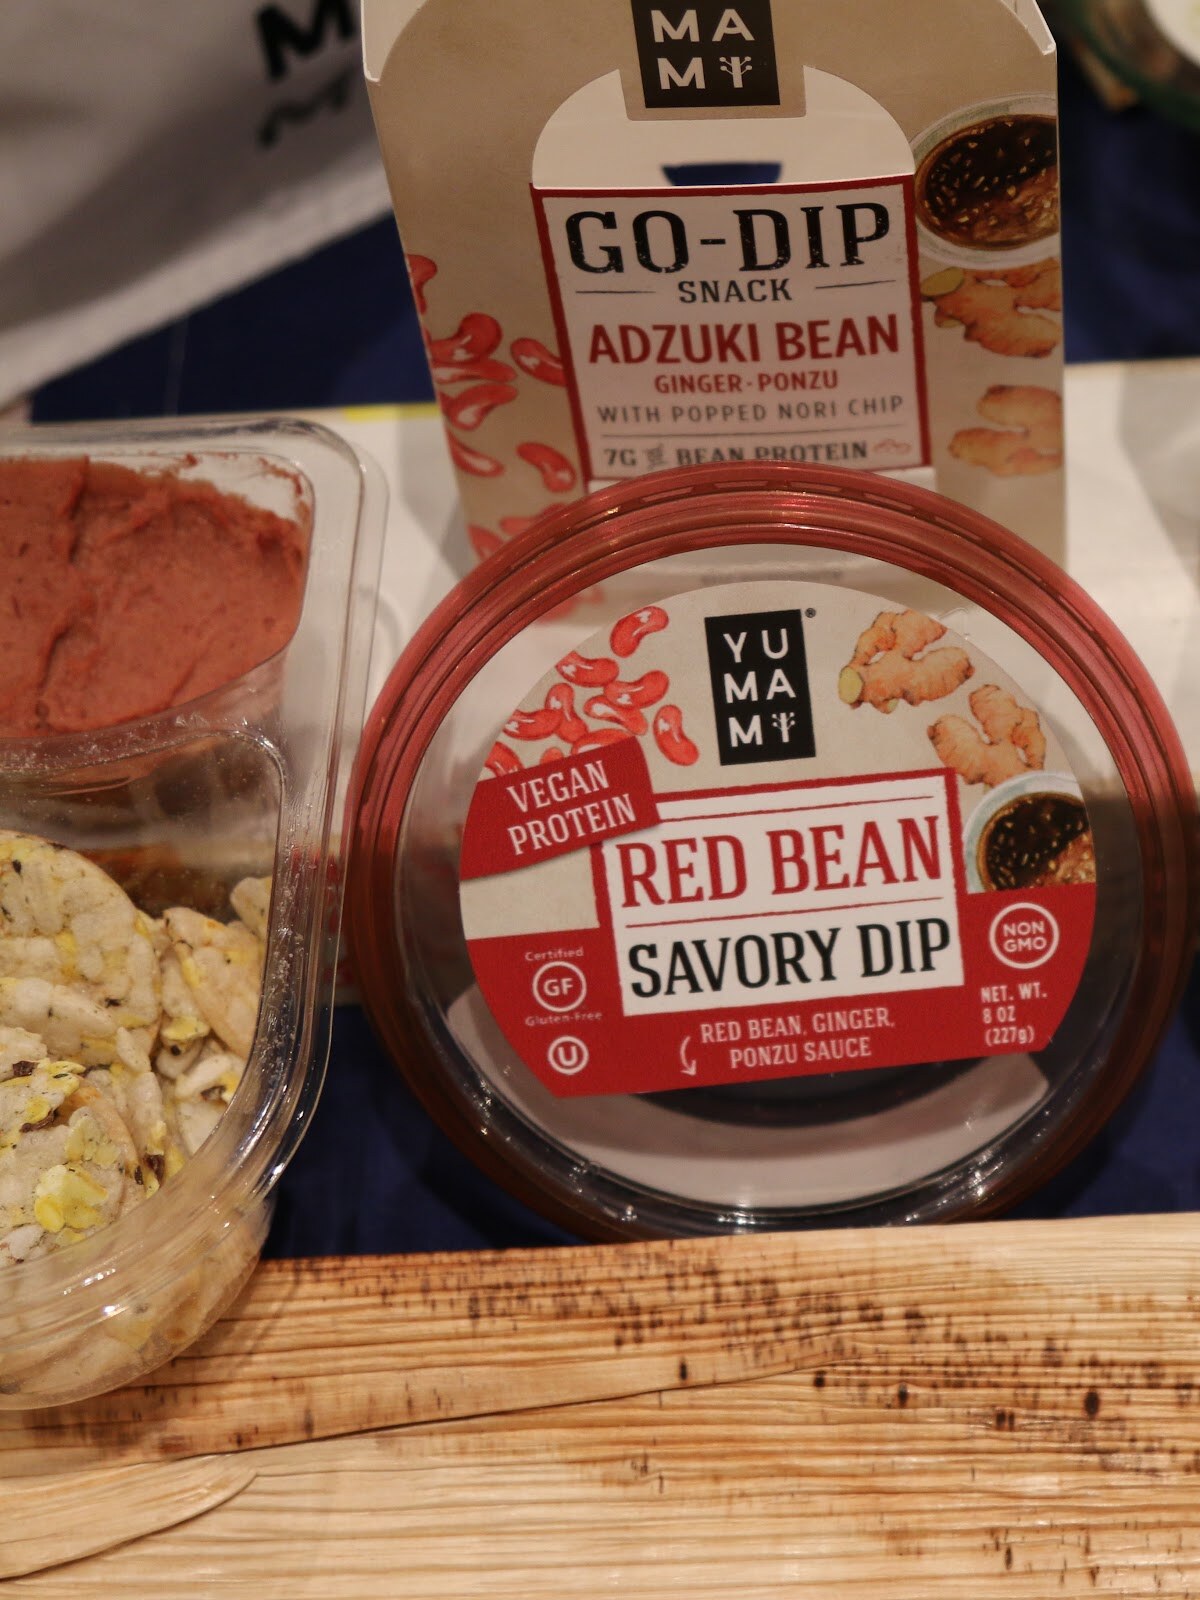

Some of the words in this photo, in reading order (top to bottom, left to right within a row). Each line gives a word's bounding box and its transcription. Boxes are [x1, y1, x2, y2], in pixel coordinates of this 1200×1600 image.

[565, 202, 890, 274] GO-DIP
[679, 278, 793, 304] SNACK
[588, 322, 760, 364] ADZUKI
[777, 314, 899, 358] BEAN
[597, 405, 660, 423] WITH
[672, 404, 767, 422] POPPED
[779, 402, 837, 420] NORI
[848, 395, 904, 416] CHIP
[604, 448, 637, 467] 7G
[676, 448, 744, 465] BEAN
[755, 440, 868, 461] PROTEIN
[507, 760, 609, 813] VEGAN
[507, 793, 636, 856] PROTEIN
[618, 831, 748, 908] RED
[770, 815, 943, 895] BEAN
[1003, 921, 1045, 937] NON
[525, 946, 584, 961] Certified
[1003, 937, 1047, 952] GMO
[628, 927, 843, 999] SAVORY
[858, 917, 951, 977] DIP
[543, 978, 573, 996] GF
[981, 985, 1014, 1003] NET.
[1018, 982, 1047, 1000] WT.
[525, 1011, 602, 1026] Gluten-Free
[982, 1008, 992, 1024] 8
[996, 1005, 1016, 1023] OZ
[701, 1021, 741, 1043] RED
[985, 1025, 1034, 1047] (227g)
[730, 1043, 797, 1069] PONZU
[805, 1037, 871, 1062] SAUCE
